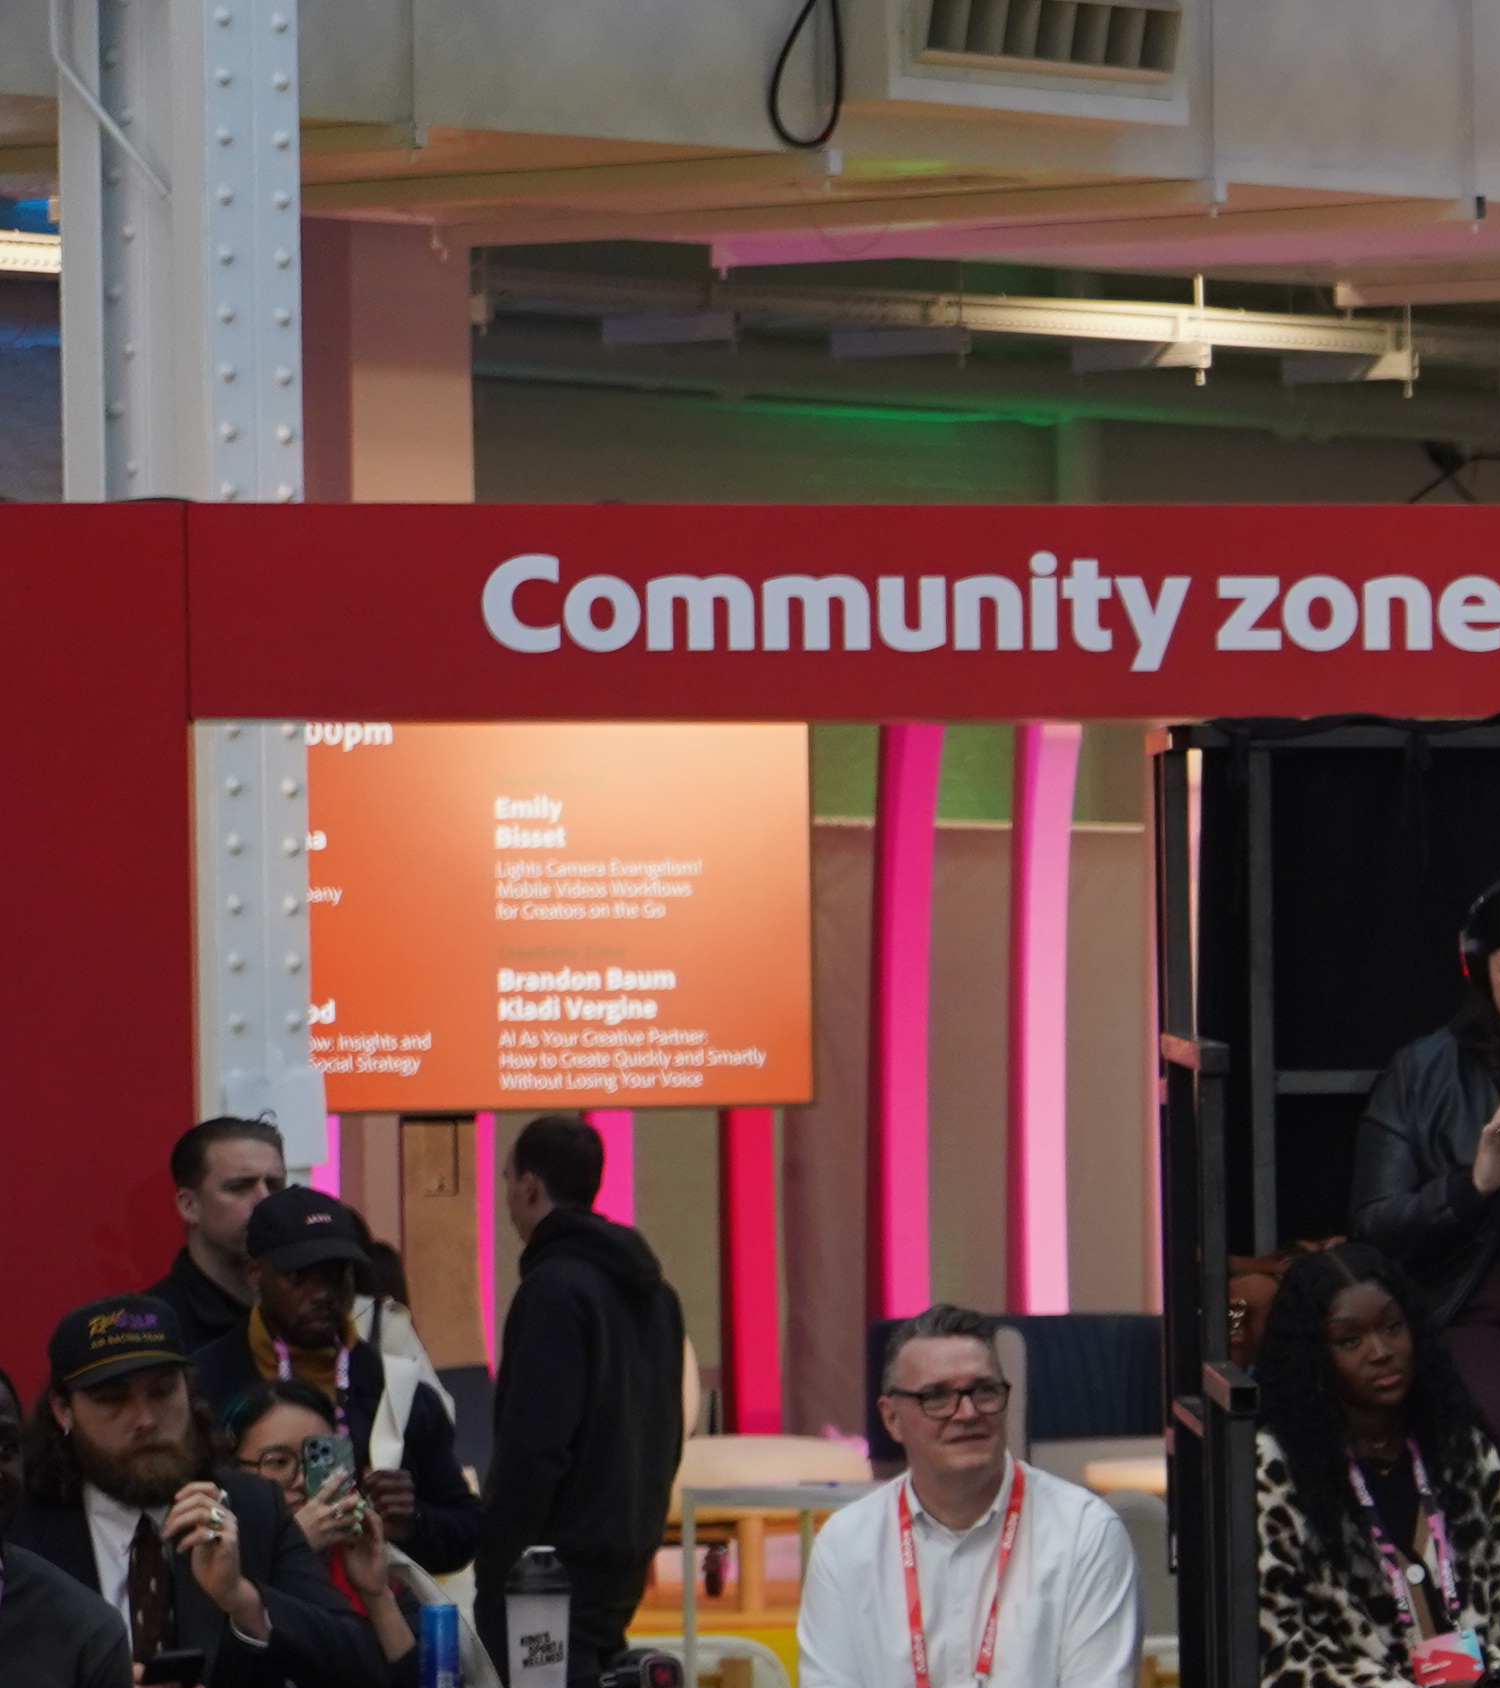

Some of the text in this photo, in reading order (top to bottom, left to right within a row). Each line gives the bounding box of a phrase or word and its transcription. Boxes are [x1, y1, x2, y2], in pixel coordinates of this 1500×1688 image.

[481, 550, 1190, 673] Community
[495, 796, 563, 824] Emily
[495, 825, 567, 848] Bisset
[496, 861, 543, 881] Lights
[546, 859, 606, 878] Camera
[496, 879, 693, 899] Mobile Videos Workflows
[497, 900, 666, 919] for Creators on the Go
[497, 965, 676, 992] Brandon Baum
[498, 994, 658, 1025] Kladi Vergine
[337, 1031, 398, 1056] Insights
[400, 1030, 432, 1051] and
[499, 1032, 516, 1048] AI
[519, 1031, 540, 1047] As
[542, 1030, 579, 1047] Your
[582, 1028, 645, 1047] Creative
[356, 1053, 421, 1077] Strategy
[499, 1047, 767, 1070] How to Create Quickly and Smartly
[499, 1070, 704, 1093] Without Losing Your Voice
